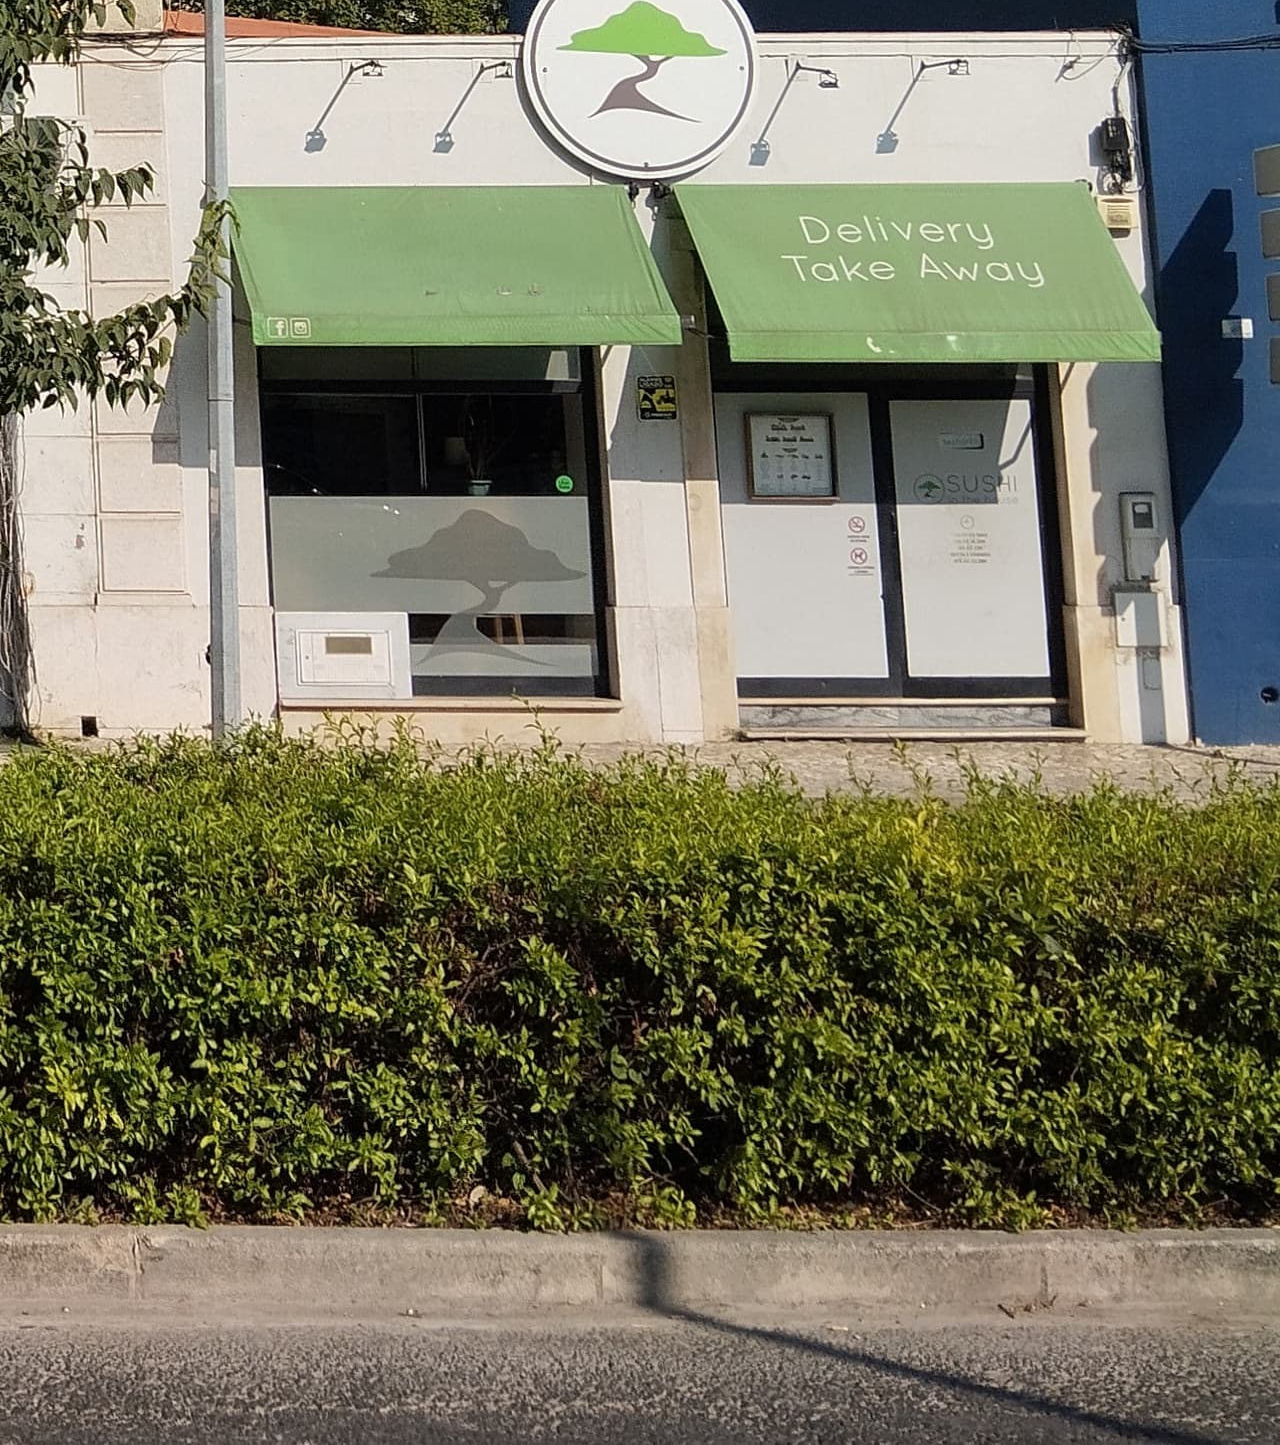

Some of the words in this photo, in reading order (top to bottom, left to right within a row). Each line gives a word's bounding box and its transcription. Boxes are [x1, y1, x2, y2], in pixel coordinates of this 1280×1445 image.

[798, 215, 995, 250] Delivery
[781, 255, 895, 282] Take
[920, 252, 1045, 288] Away
[946, 474, 1018, 494] SUSHI
